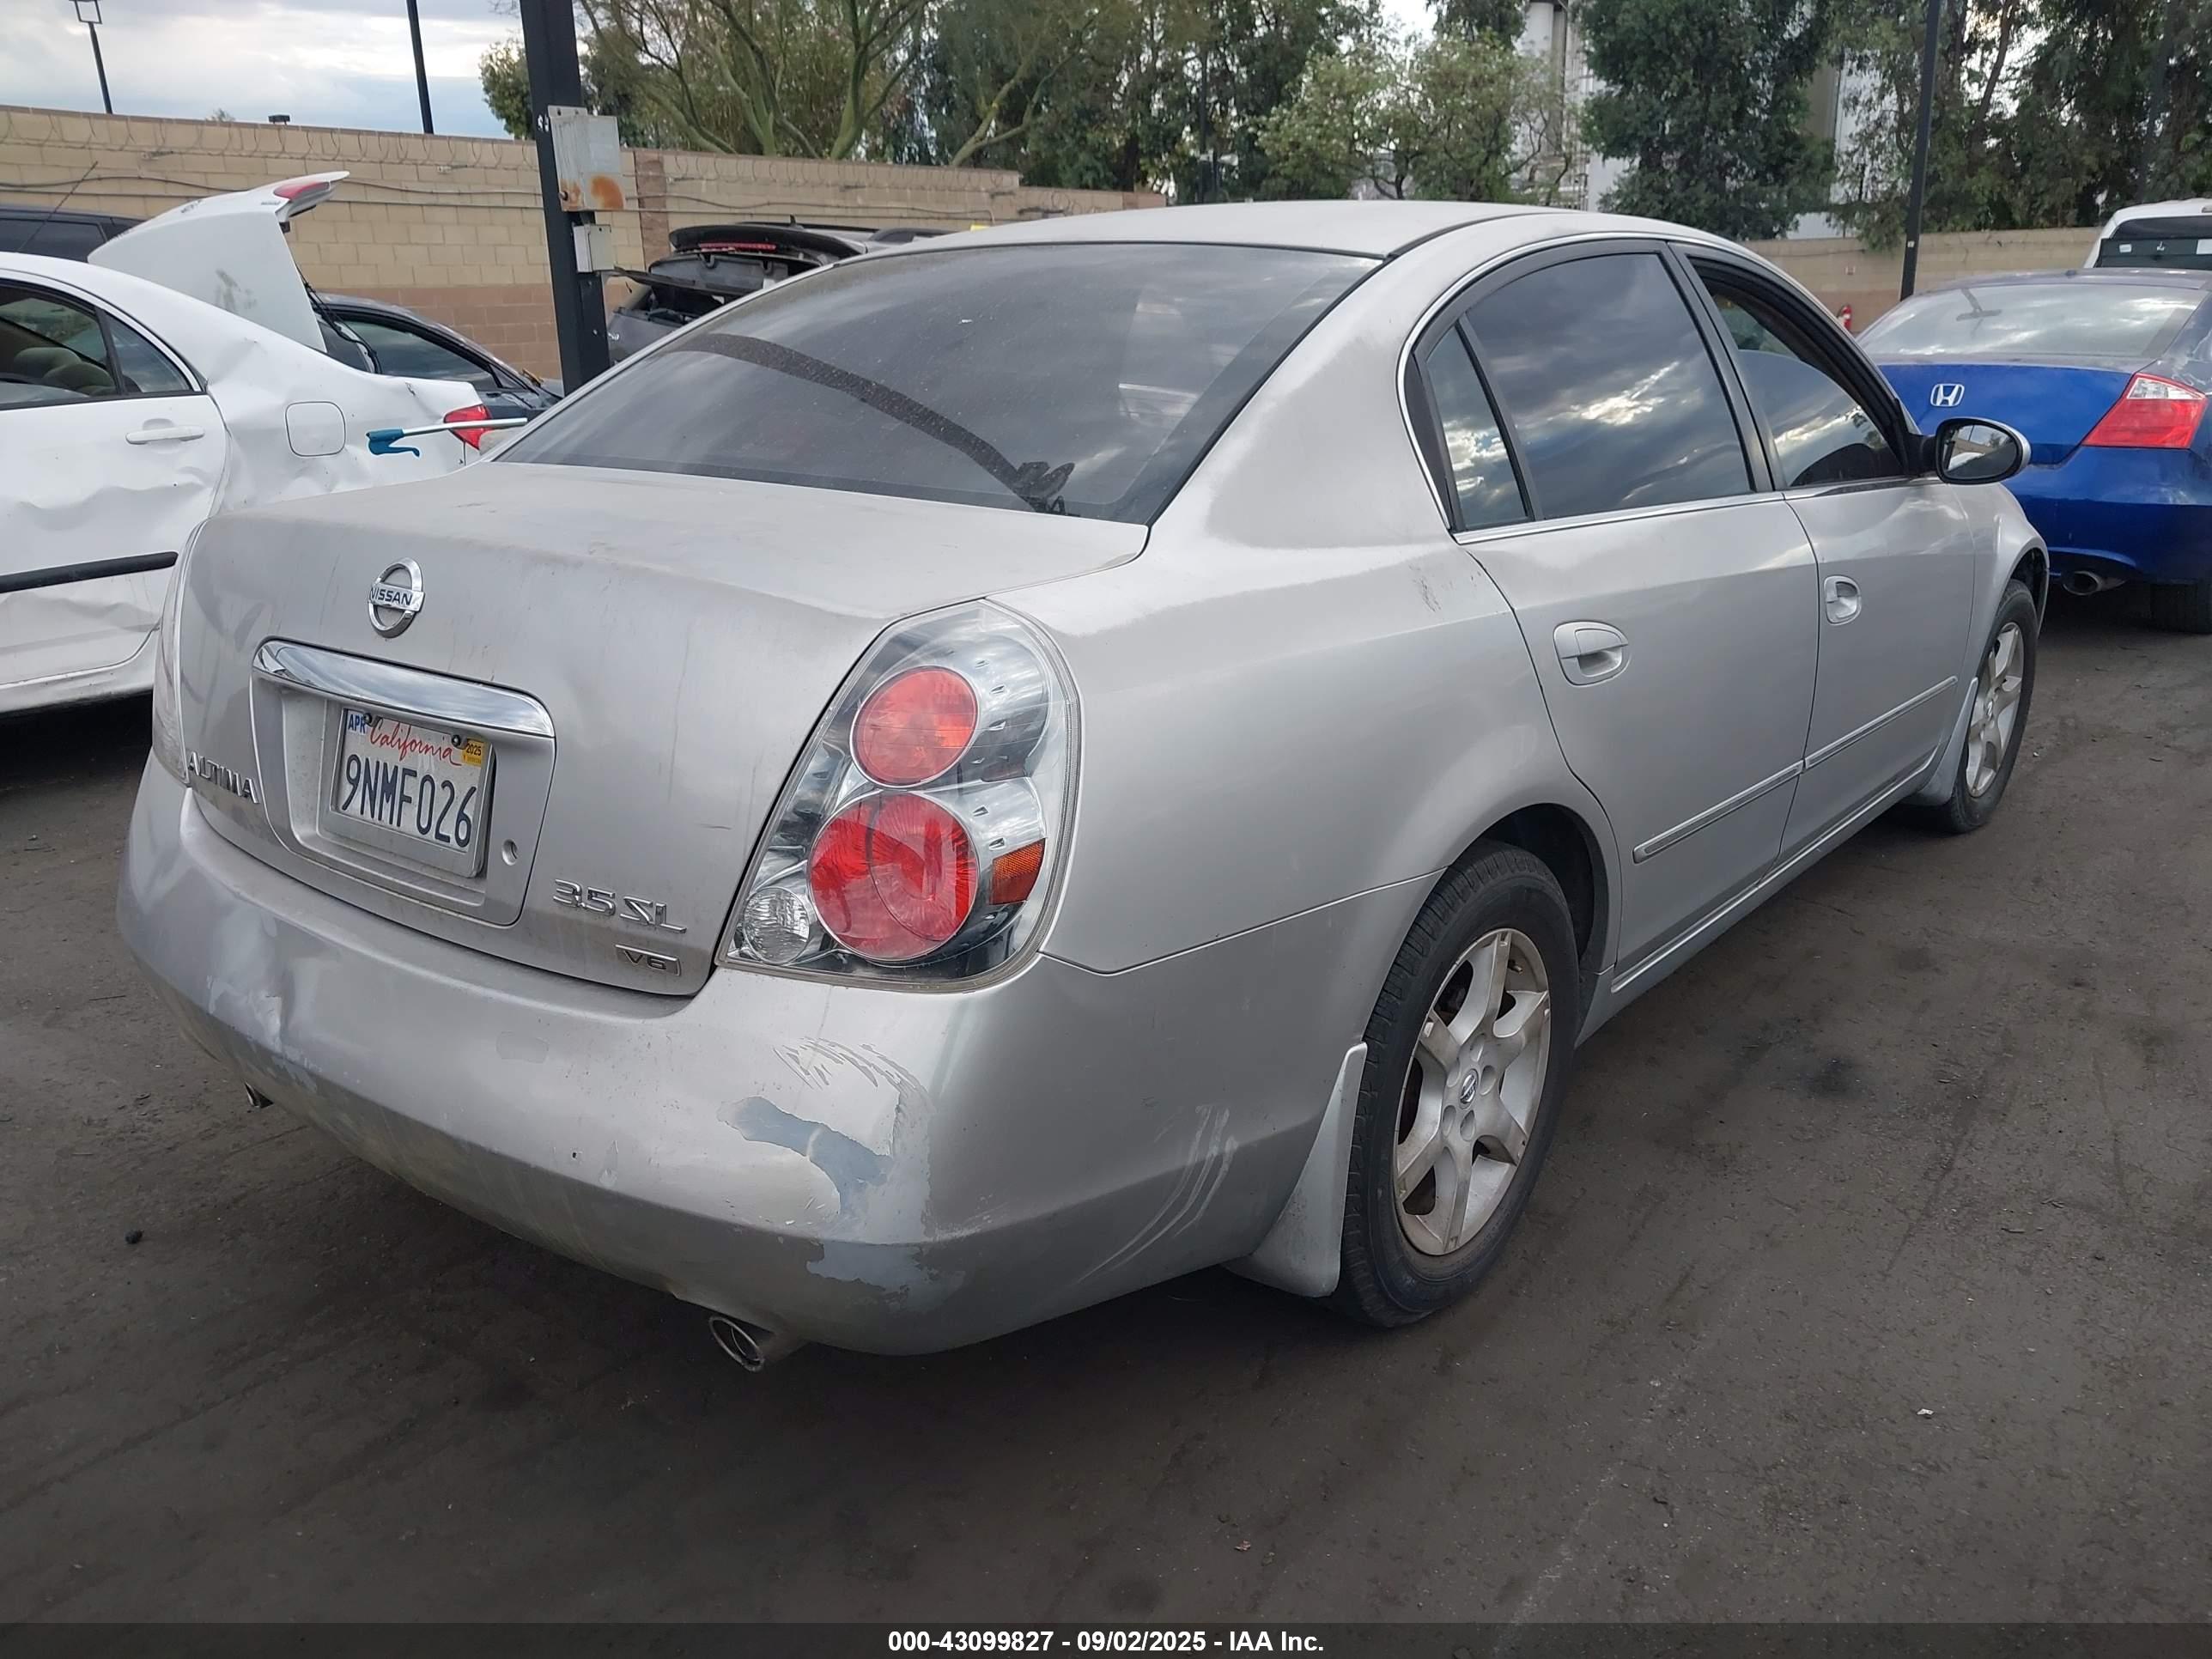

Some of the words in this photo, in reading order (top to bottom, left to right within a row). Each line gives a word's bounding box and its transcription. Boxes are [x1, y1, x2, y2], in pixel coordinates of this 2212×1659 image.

[370, 586, 412, 605] NISSAN
[348, 714, 366, 734] APR
[369, 716, 462, 767] California
[465, 743, 482, 756] 2025
[188, 751, 260, 805] ALTIMA
[342, 754, 477, 848] 9NMF026
[620, 896, 686, 933] SL
[623, 950, 667, 970] V6
